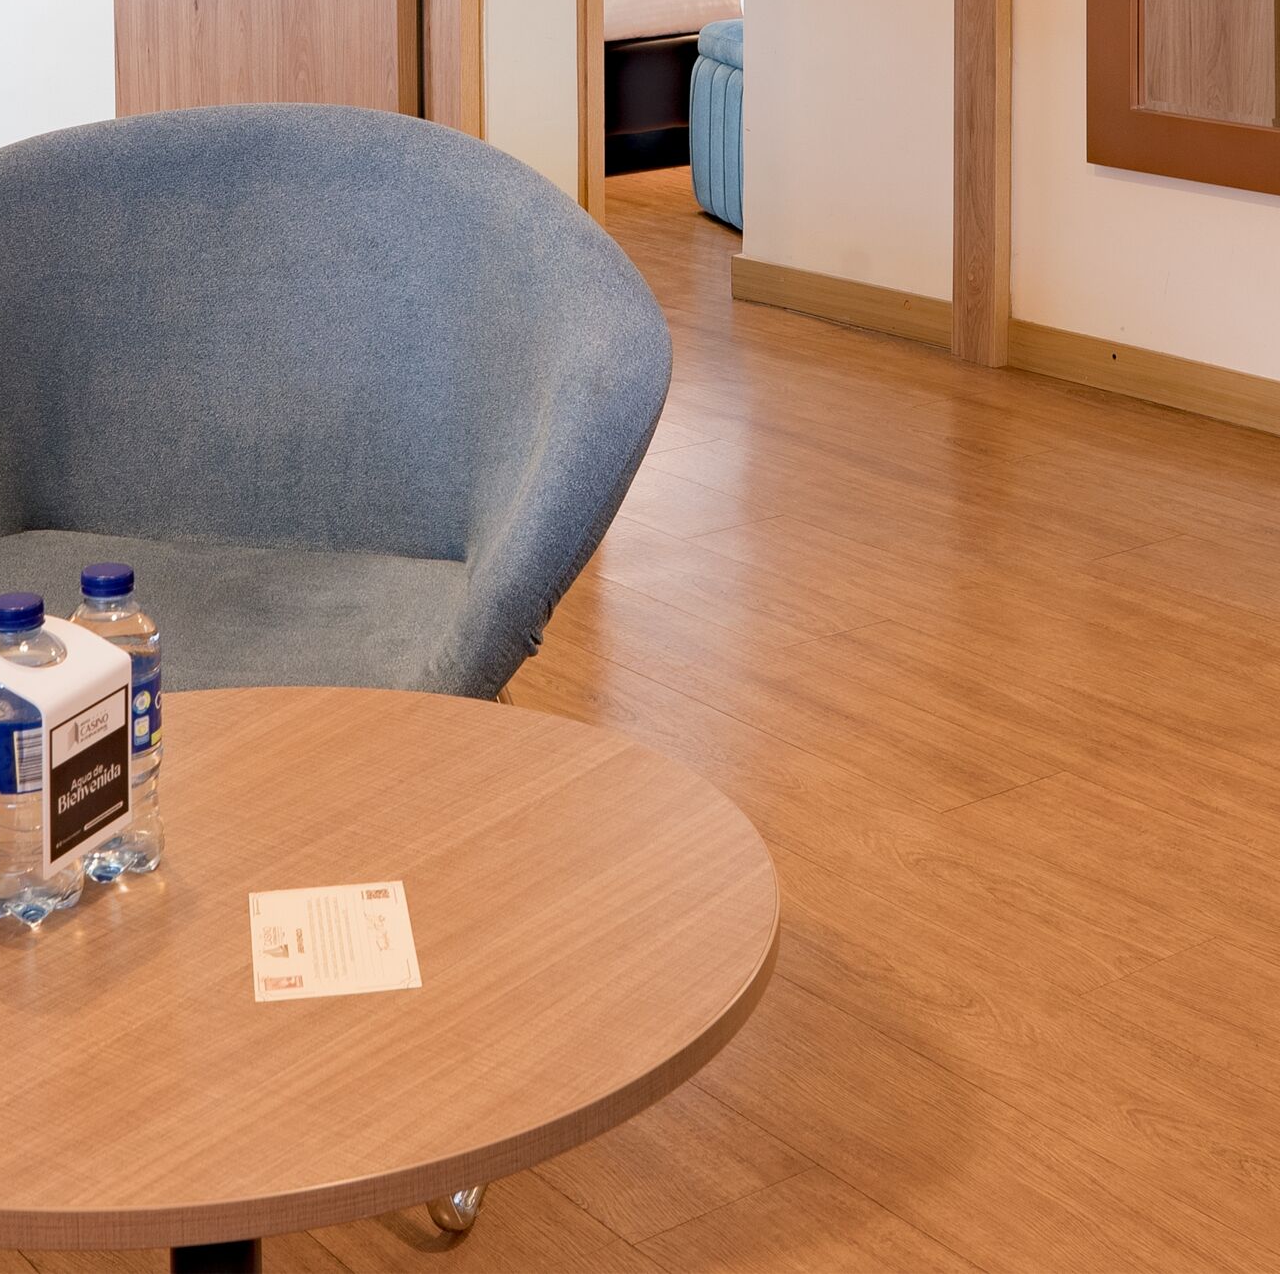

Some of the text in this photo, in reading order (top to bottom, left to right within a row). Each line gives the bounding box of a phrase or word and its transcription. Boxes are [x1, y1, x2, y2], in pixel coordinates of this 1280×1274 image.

[80, 713, 109, 736] CASINO
[58, 763, 121, 814] Bienvenida
[71, 764, 103, 791] Agua de
